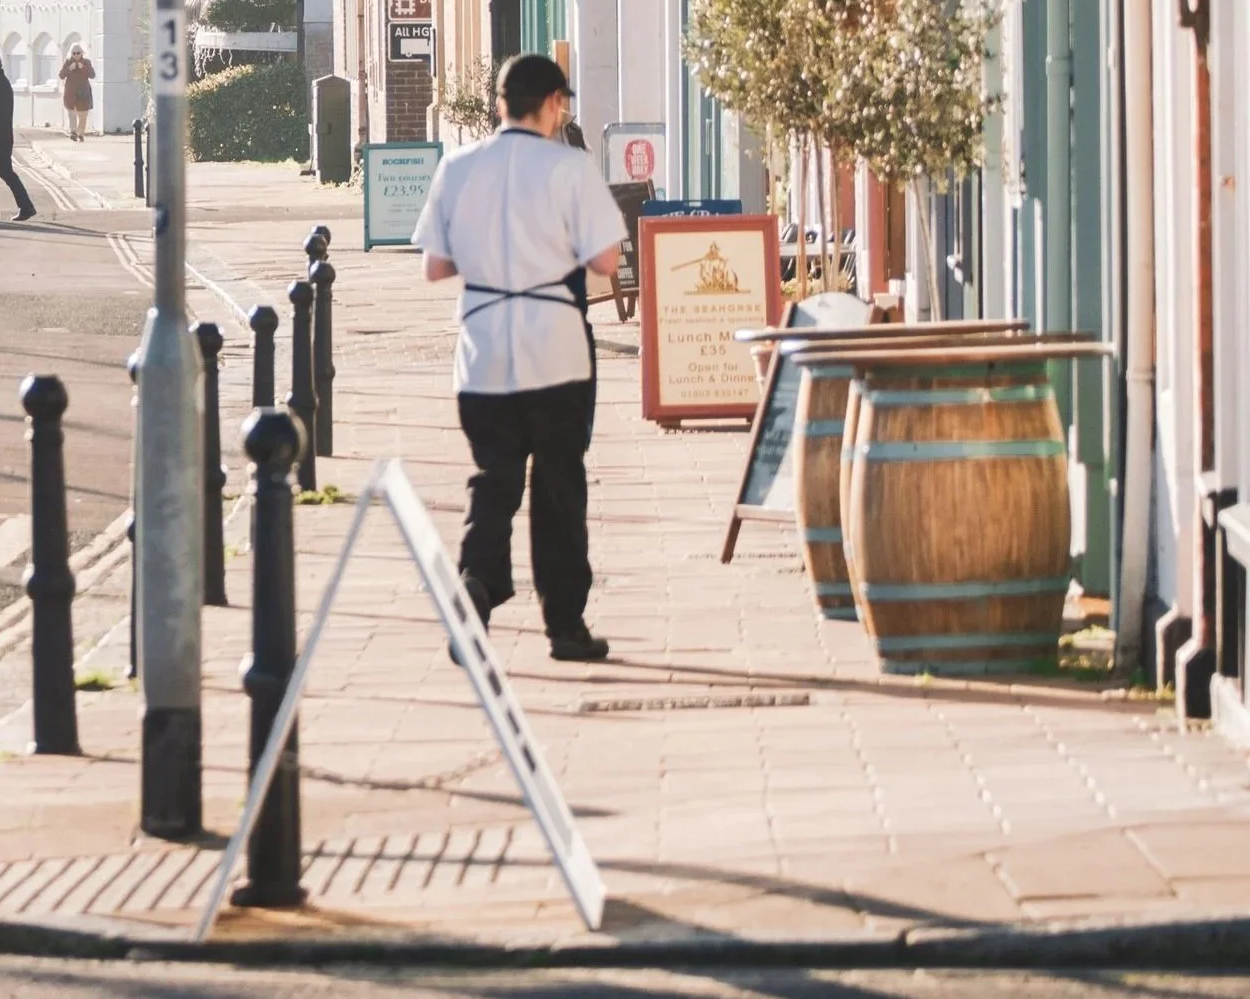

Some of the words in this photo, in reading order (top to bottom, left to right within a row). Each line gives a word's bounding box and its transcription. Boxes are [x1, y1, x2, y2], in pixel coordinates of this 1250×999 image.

[395, 26, 410, 37] All
[383, 184, 424, 197] £23.95
[664, 305, 686, 314] THE
[694, 304, 761, 314] SEAHORSE
[668, 332, 712, 343] Lunch
[700, 344, 726, 357] £35
[688, 362, 719, 373] Open
[723, 362, 738, 372] for
[668, 374, 704, 385] Lunch
[709, 375, 716, 383] &
